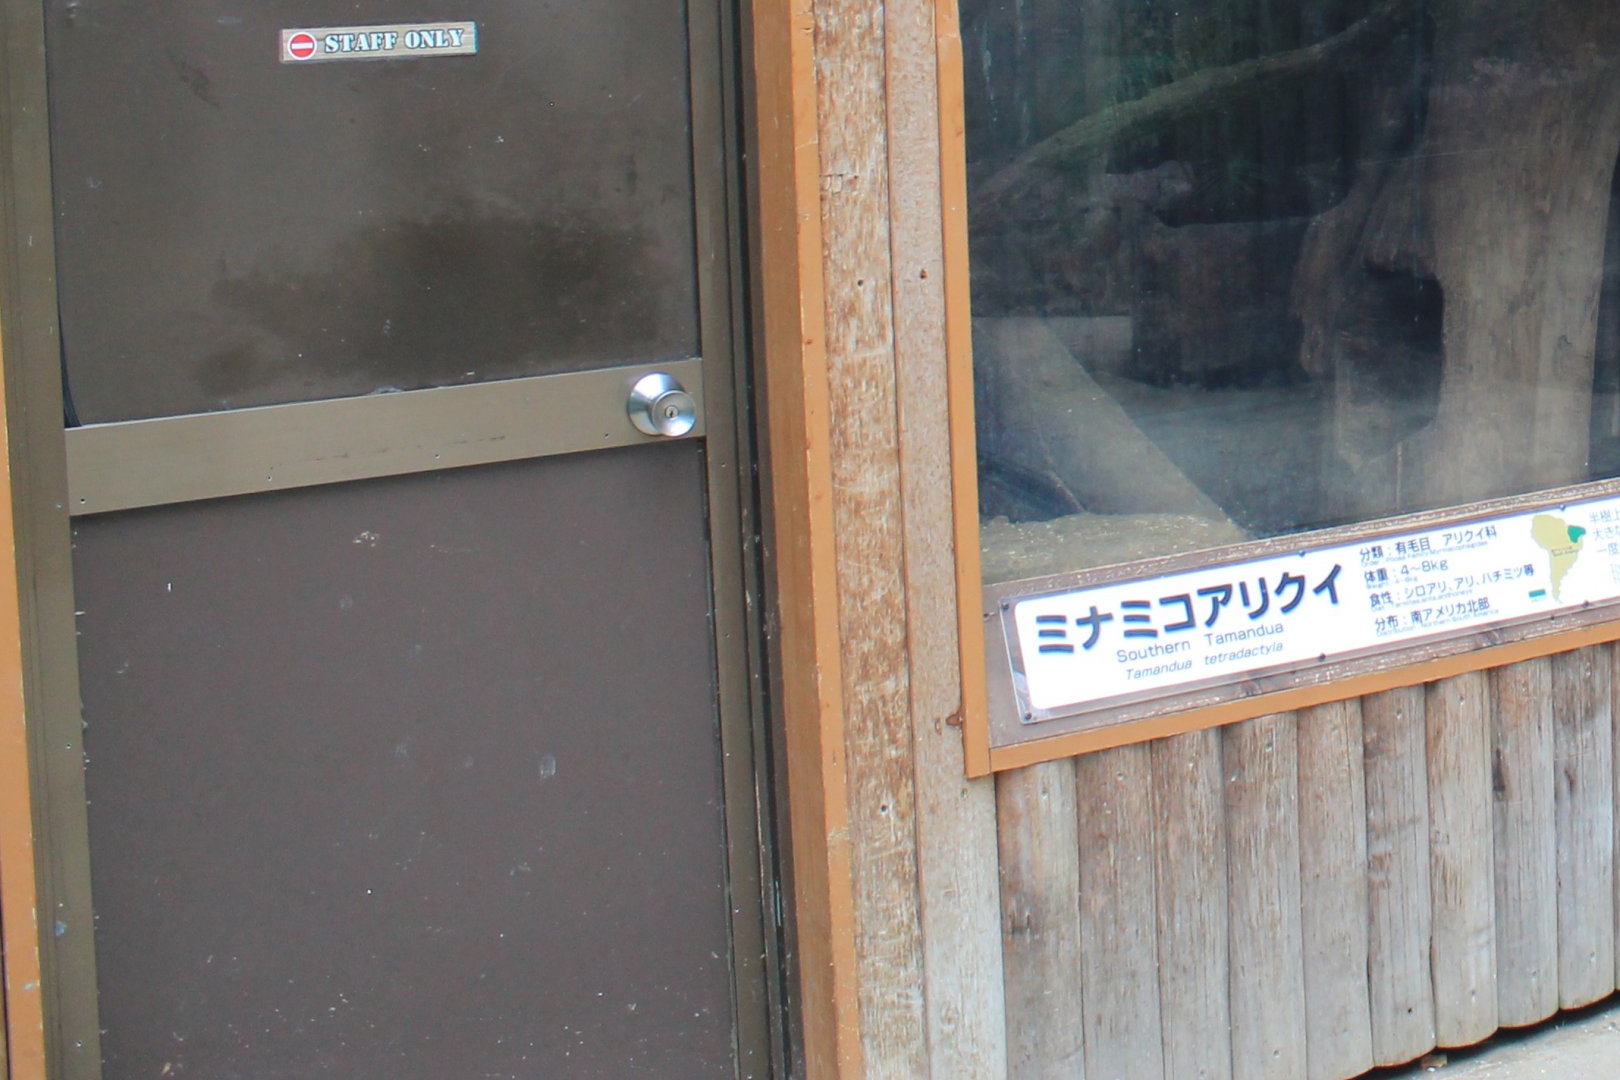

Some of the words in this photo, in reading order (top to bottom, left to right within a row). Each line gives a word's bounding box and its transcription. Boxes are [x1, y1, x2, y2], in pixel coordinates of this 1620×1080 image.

[324, 32, 398, 53] STAFF
[404, 29, 464, 49] ONLY
[1036, 564, 1343, 654] ミナミコアリクイ
[1116, 639, 1191, 663] Southern
[1204, 622, 1284, 646] Tamandua
[1126, 659, 1193, 680] Tamandua
[1204, 641, 1284, 666] tetradactyla
